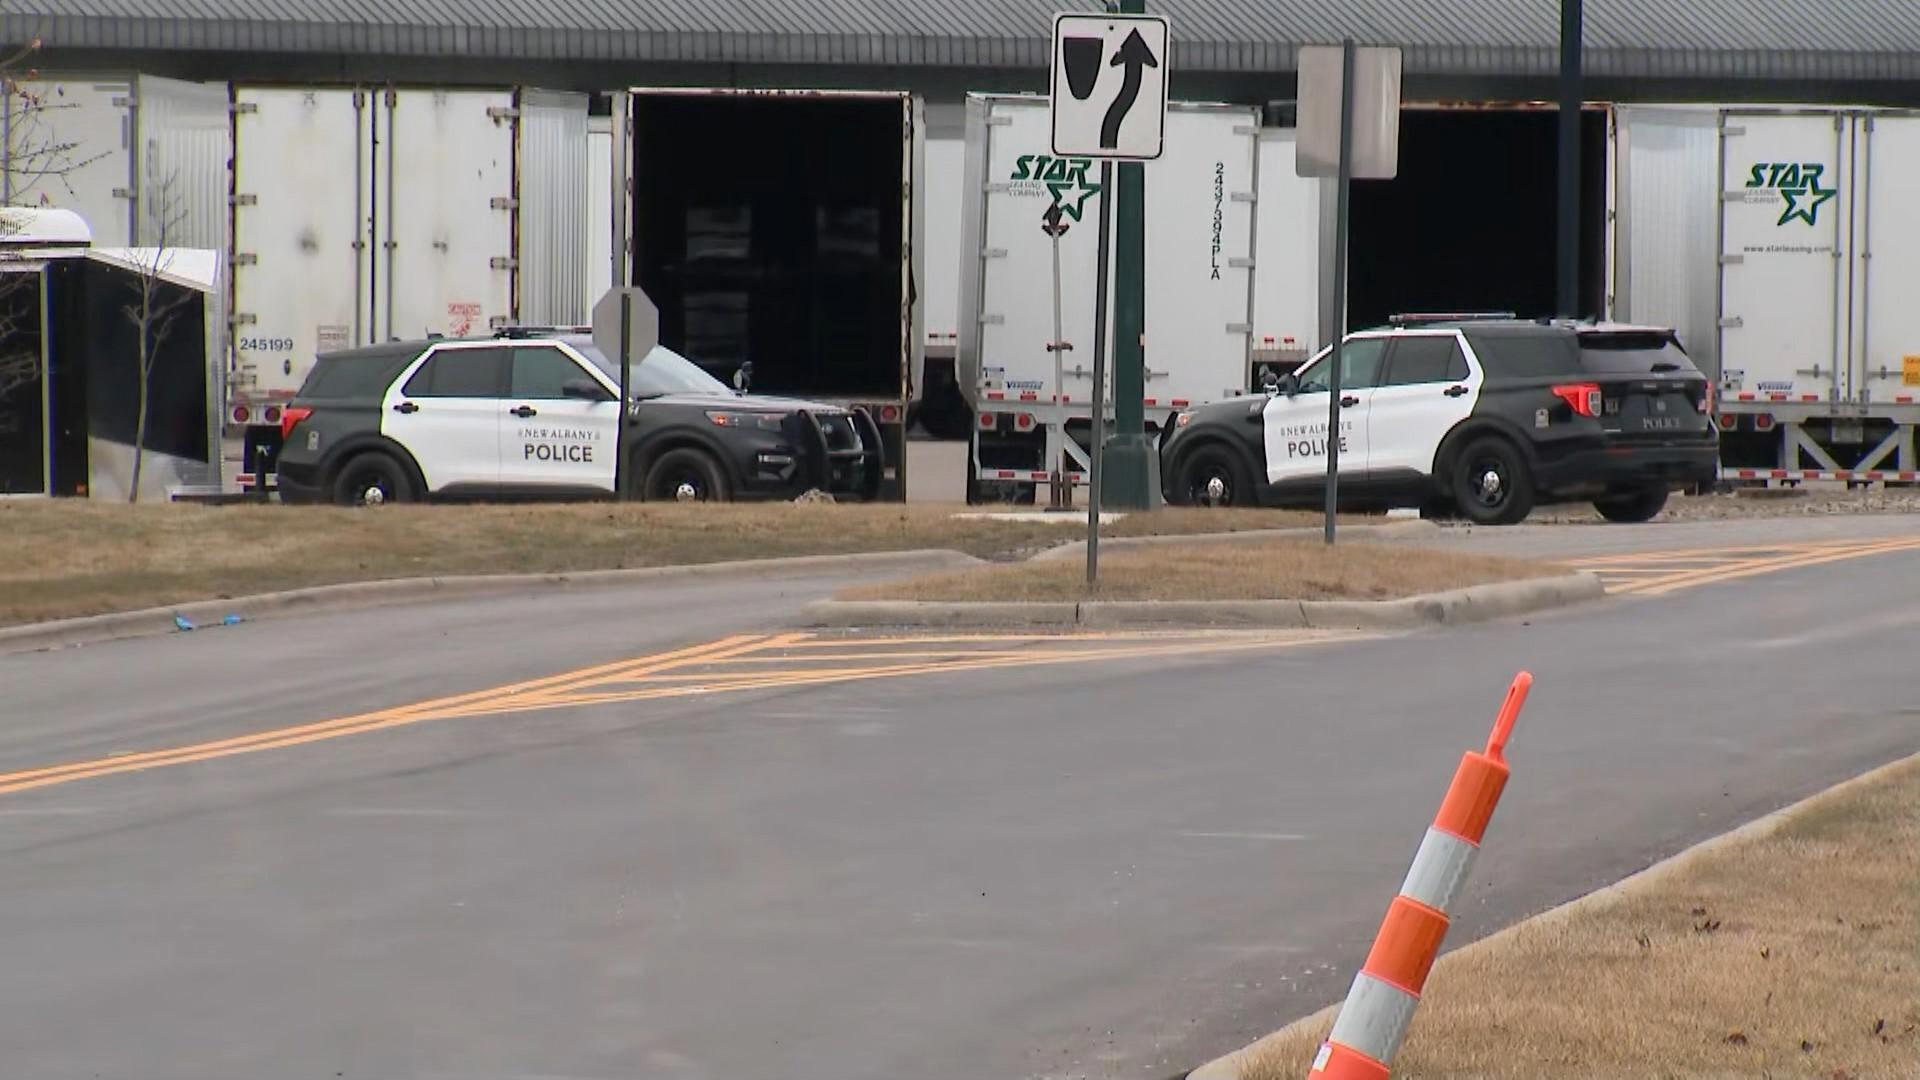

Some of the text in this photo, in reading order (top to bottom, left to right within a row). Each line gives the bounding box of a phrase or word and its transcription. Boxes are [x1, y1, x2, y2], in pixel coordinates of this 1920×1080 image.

[1010, 155, 1092, 183] STAR
[1745, 163, 1824, 189] STAR
[239, 338, 294, 351] 245199
[524, 428, 593, 440] NEW ALBANY
[1287, 421, 1346, 437] NEW ALBY
[524, 443, 593, 462] POLICE
[1287, 436, 1348, 459] POLIE
